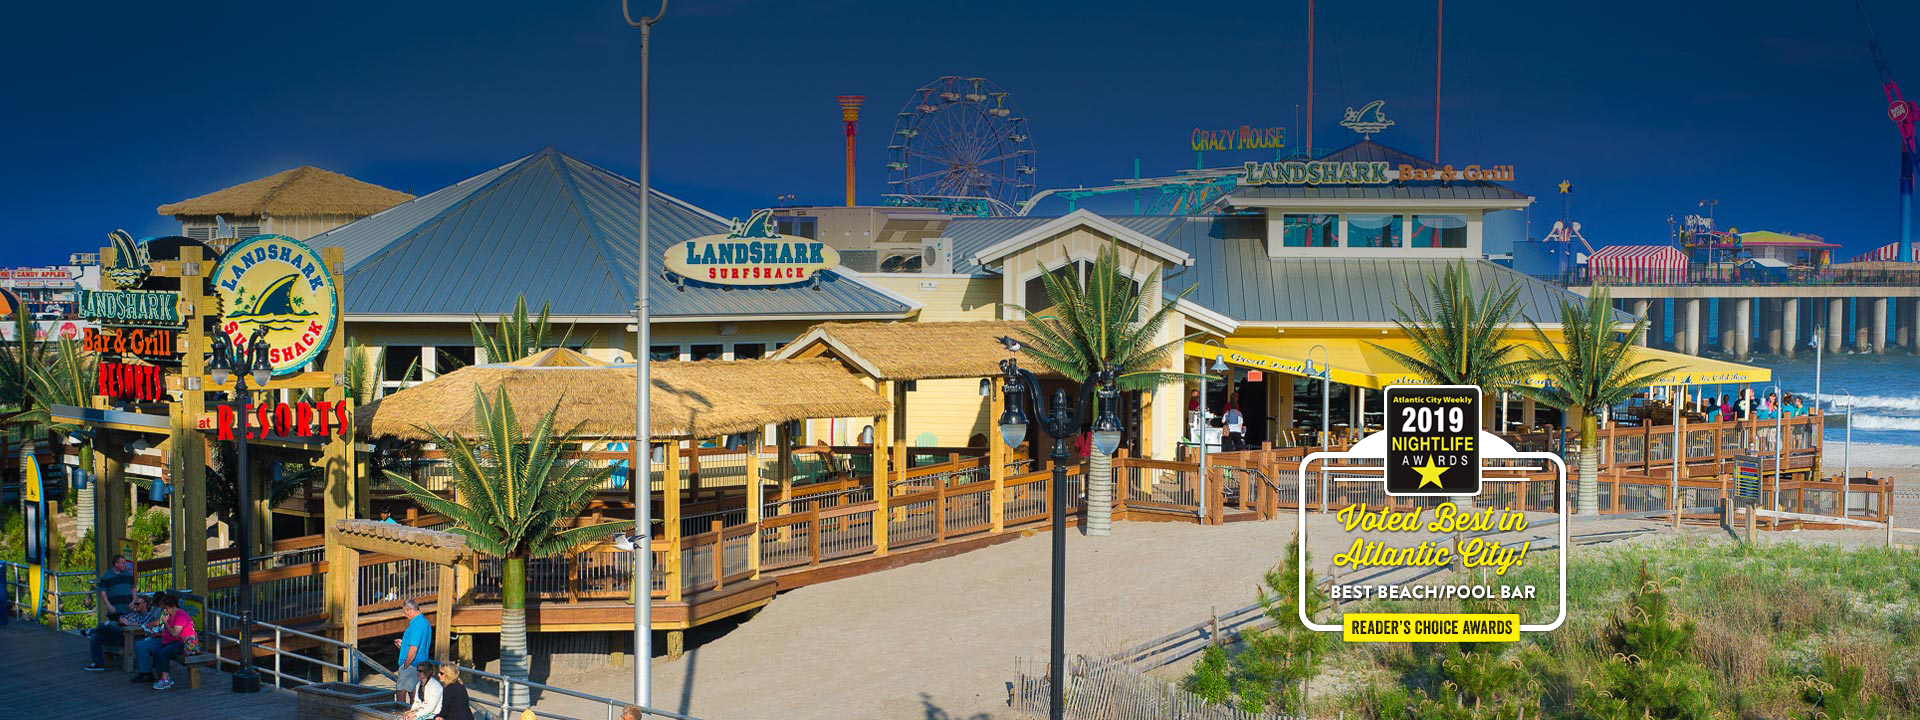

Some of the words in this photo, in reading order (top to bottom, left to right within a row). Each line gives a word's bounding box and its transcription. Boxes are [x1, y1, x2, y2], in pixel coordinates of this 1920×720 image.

[1191, 127, 1235, 151] CRAZY
[1237, 125, 1285, 150] MOUSE
[1244, 161, 1390, 184] LANDSHARK
[1398, 164, 1435, 182] Bar
[1440, 164, 1457, 182] &
[1463, 164, 1514, 182] Grill
[220, 244, 325, 293] LANDSHARK
[708, 267, 804, 279] SURFSHACK
[78, 290, 172, 320] LANDSHARK
[83, 327, 110, 352] Bar
[113, 327, 127, 353] &
[131, 328, 171, 356] Grill
[224, 320, 324, 365] SUSHACK
[98, 362, 161, 400] RESORTS
[198, 419, 211, 429] at
